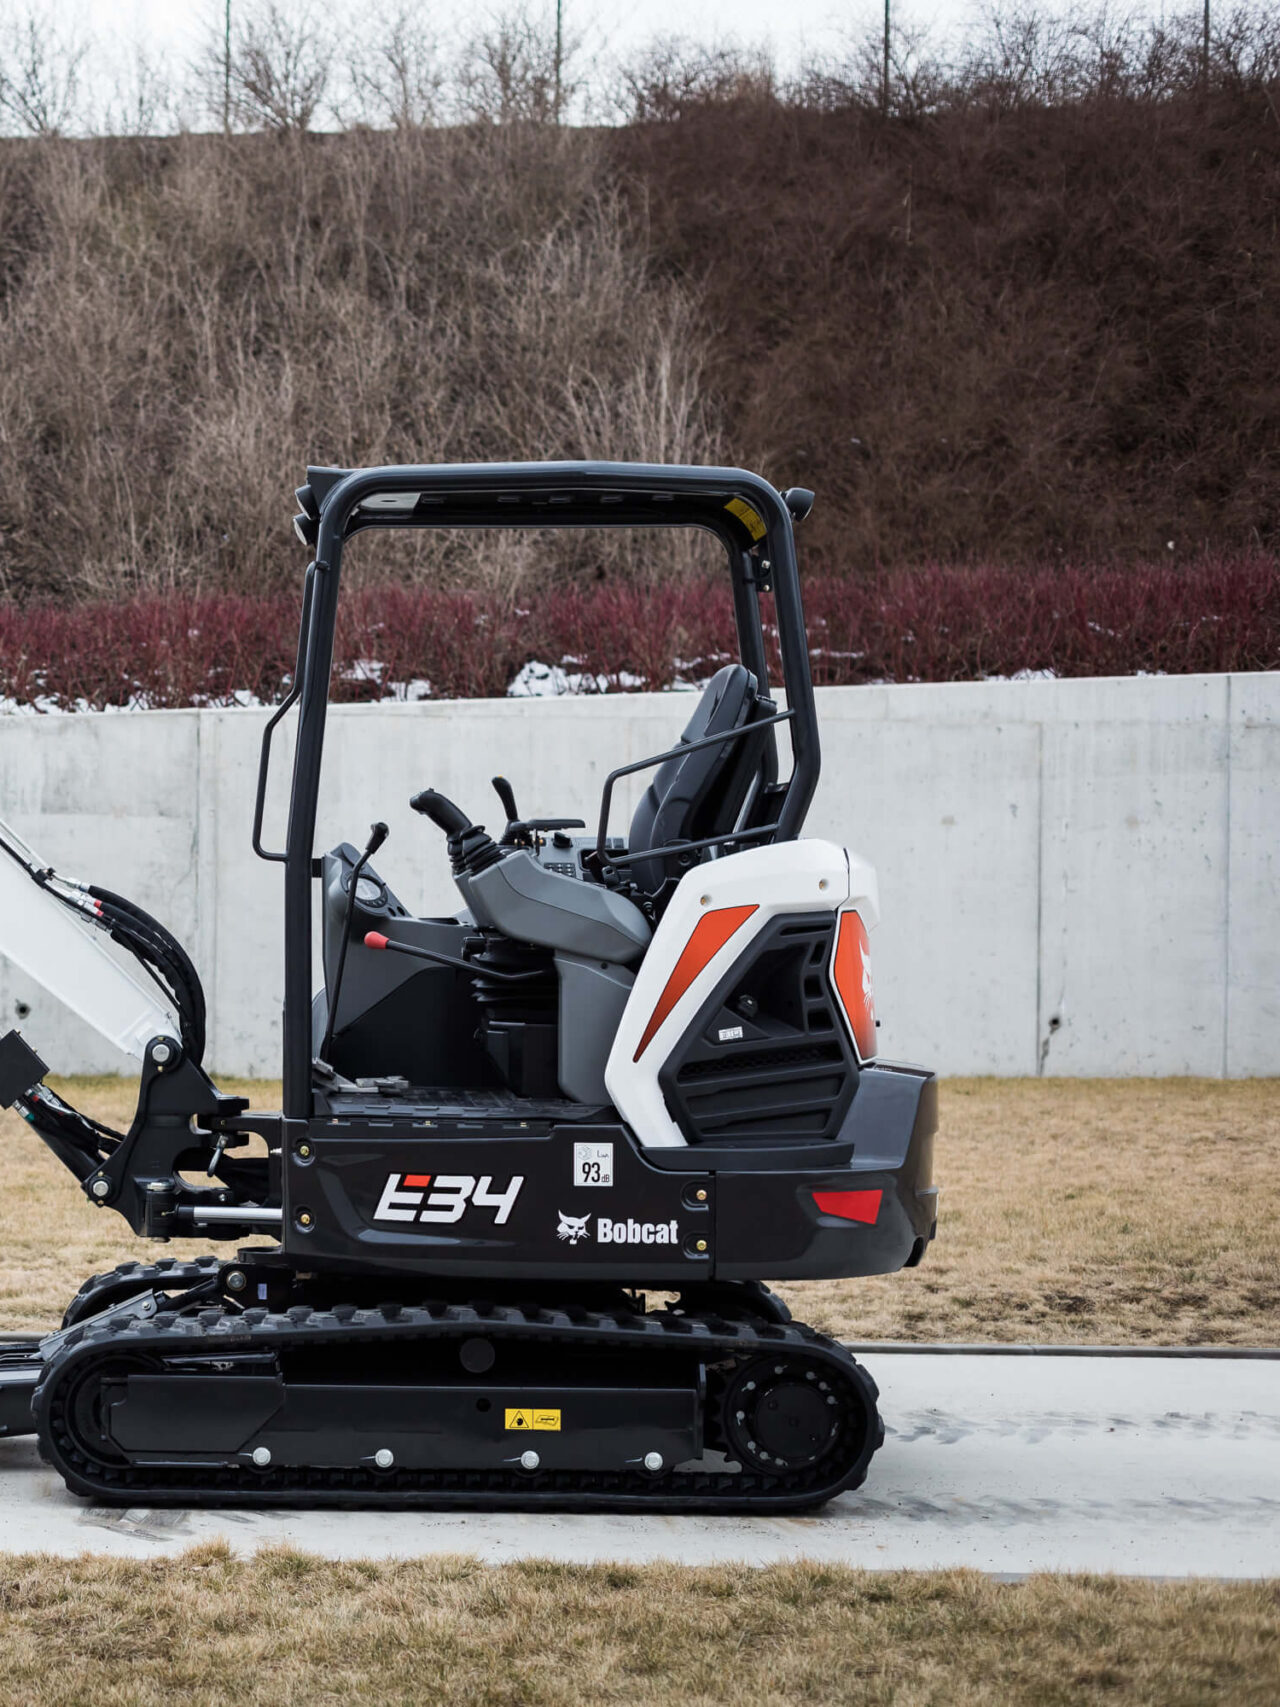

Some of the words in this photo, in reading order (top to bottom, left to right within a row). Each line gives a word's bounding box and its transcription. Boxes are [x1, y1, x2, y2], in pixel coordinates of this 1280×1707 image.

[582, 1161, 601, 1183] 93
[601, 1173, 610, 1183] dB
[373, 1173, 525, 1225] E34
[597, 1217, 679, 1245] Bobcat
